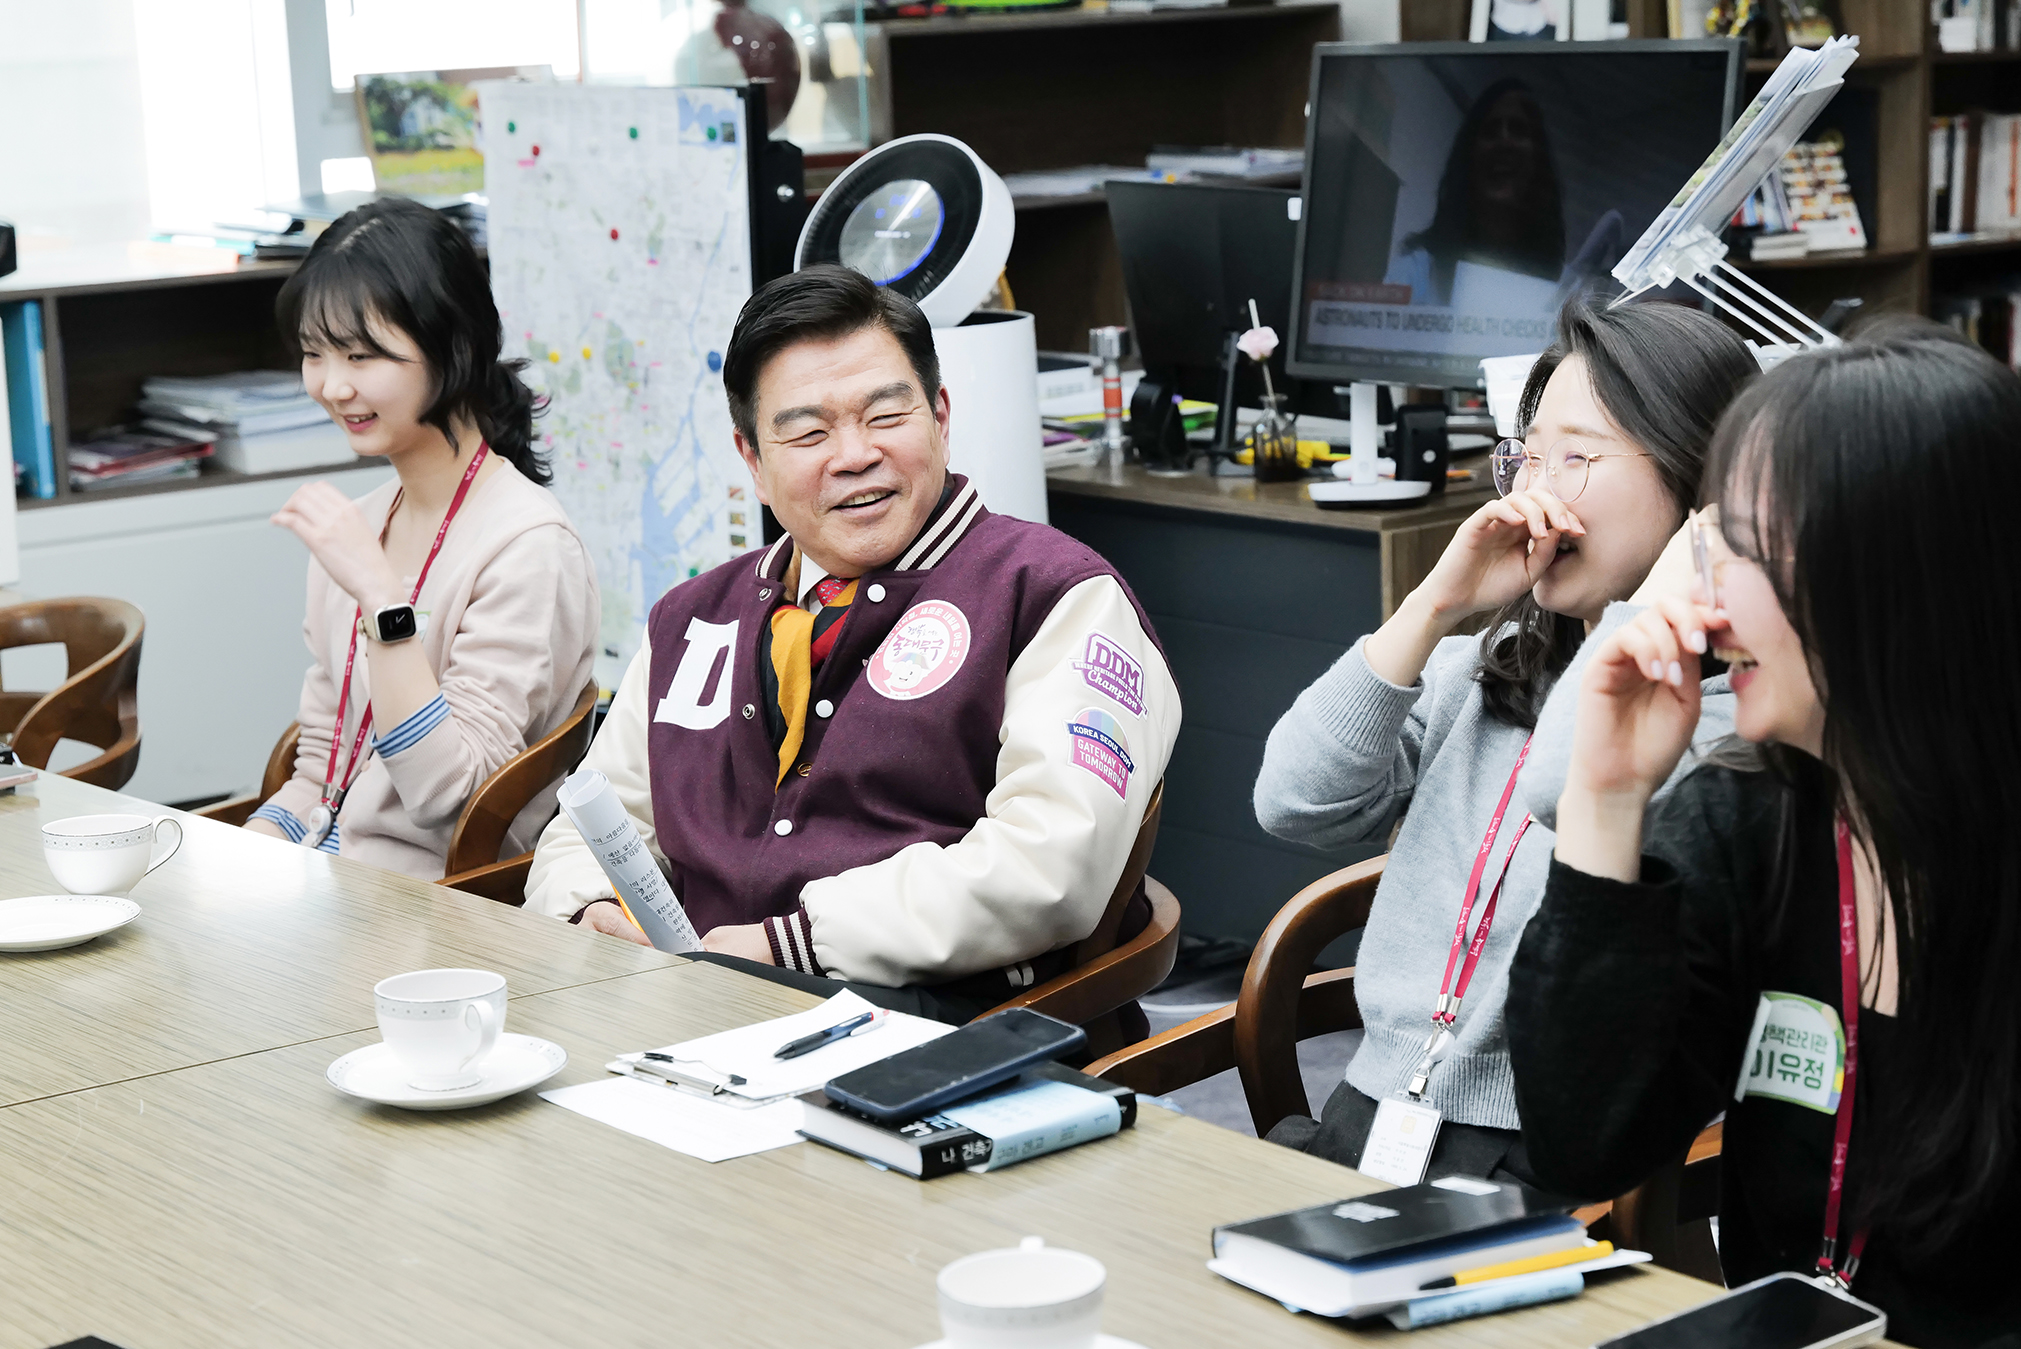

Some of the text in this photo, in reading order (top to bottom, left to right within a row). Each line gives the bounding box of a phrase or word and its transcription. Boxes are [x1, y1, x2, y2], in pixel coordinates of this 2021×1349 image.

[1315, 307, 1548, 339] ASTRONAUTS TO UNDERGO HEALTH CHECKS
[893, 634, 945, 661] 동대문구
[1093, 641, 1140, 695] DDM
[653, 616, 740, 731] D
[1087, 669, 1138, 711] Champion
[1073, 725, 1132, 768] KOREA SEOUL DDM
[1077, 738, 1127, 779] GATEWAY TO
[1079, 750, 1124, 789] TOMORROW
[941, 1146, 956, 1164] 나
